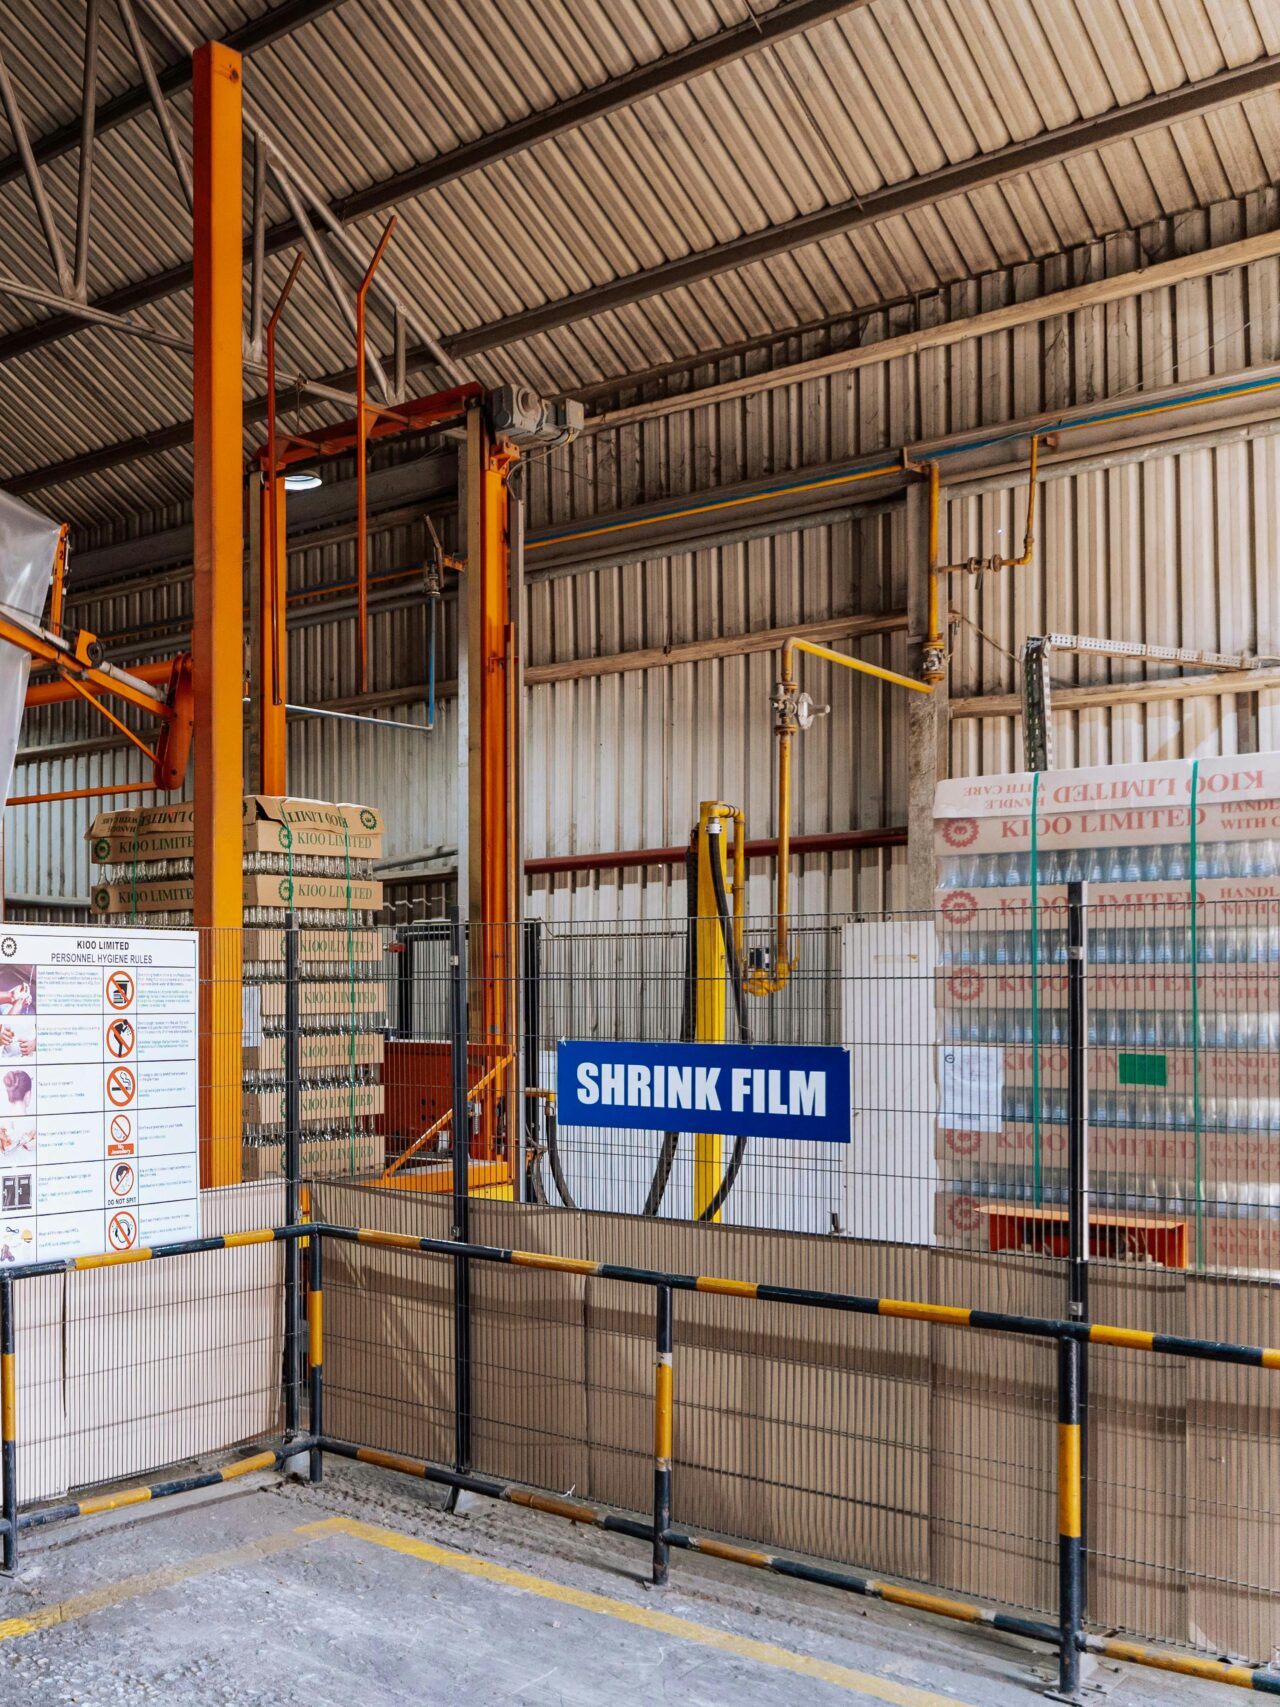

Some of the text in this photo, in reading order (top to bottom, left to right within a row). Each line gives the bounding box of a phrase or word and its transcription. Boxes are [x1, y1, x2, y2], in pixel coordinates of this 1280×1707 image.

[964, 784, 1001, 797] CARE
[1053, 769, 1265, 803] KIOO LIMITED
[1221, 799, 1280, 813] HANDL
[1001, 807, 1207, 838] KIOO LIMITED
[1221, 816, 1266, 830] WITH
[298, 832, 326, 846] KIOO
[119, 840, 149, 854] KIOO
[118, 890, 148, 904] KIOO
[298, 884, 373, 900] KIOO LIMTED
[1220, 886, 1280, 898] HANDL
[1000, 896, 1069, 916] KIOO
[1221, 903, 1267, 915] WITH
[77, 940, 130, 950] KIOO LIMITED
[51, 953, 153, 964] PERSONNEL HYGIENE RULES
[1088, 973, 1203, 993] IMITED
[576, 1062, 827, 1117] SHRINK FILM
[1088, 1136, 1197, 1159] IMITED
[107, 1198, 115, 1206] DO
[126, 1196, 137, 1204] SPIT
